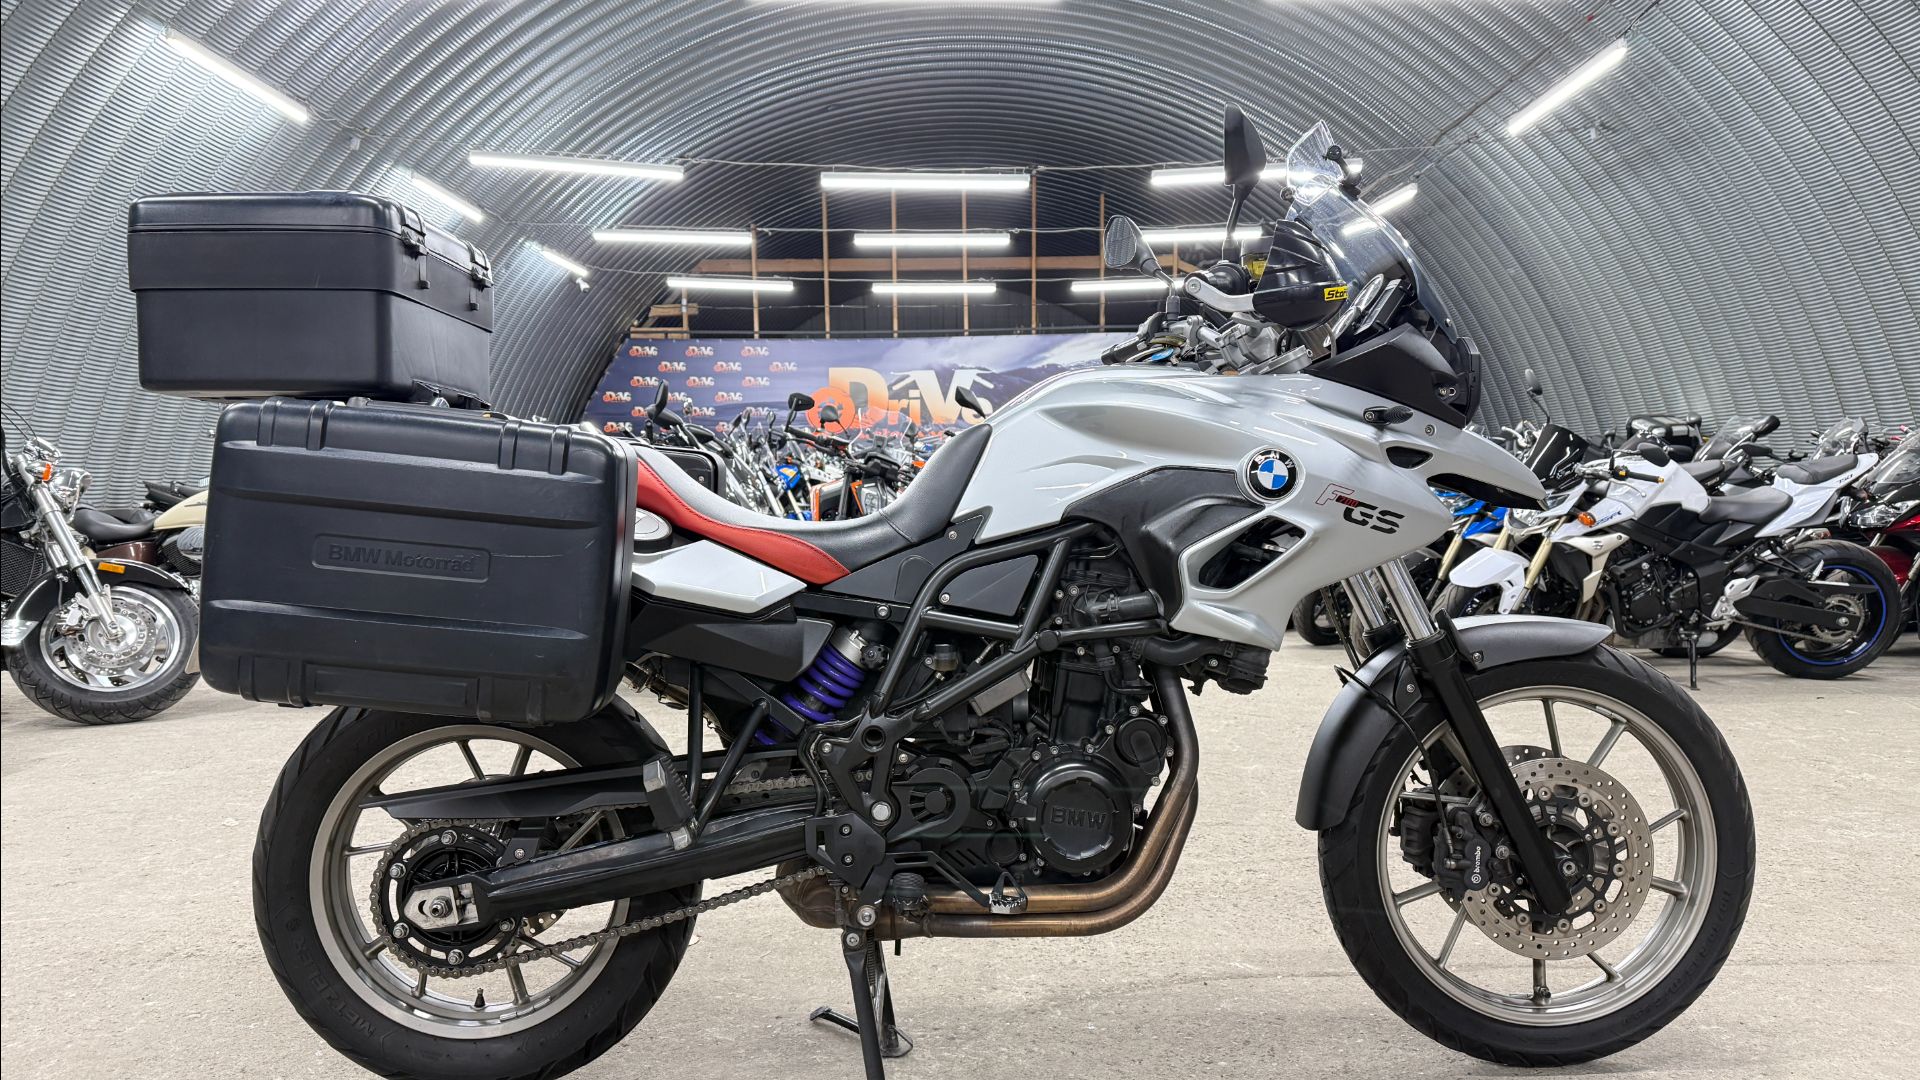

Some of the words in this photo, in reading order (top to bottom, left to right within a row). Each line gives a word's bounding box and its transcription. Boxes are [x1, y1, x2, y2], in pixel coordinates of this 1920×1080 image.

[1254, 450, 1295, 469] BMW
[1315, 483, 1354, 506] F
[1343, 500, 1405, 535] GS
[328, 544, 382, 565] BMW
[385, 551, 474, 573] Motorrad
[1051, 807, 1107, 830] BMW
[1473, 846, 1481, 873] brembo
